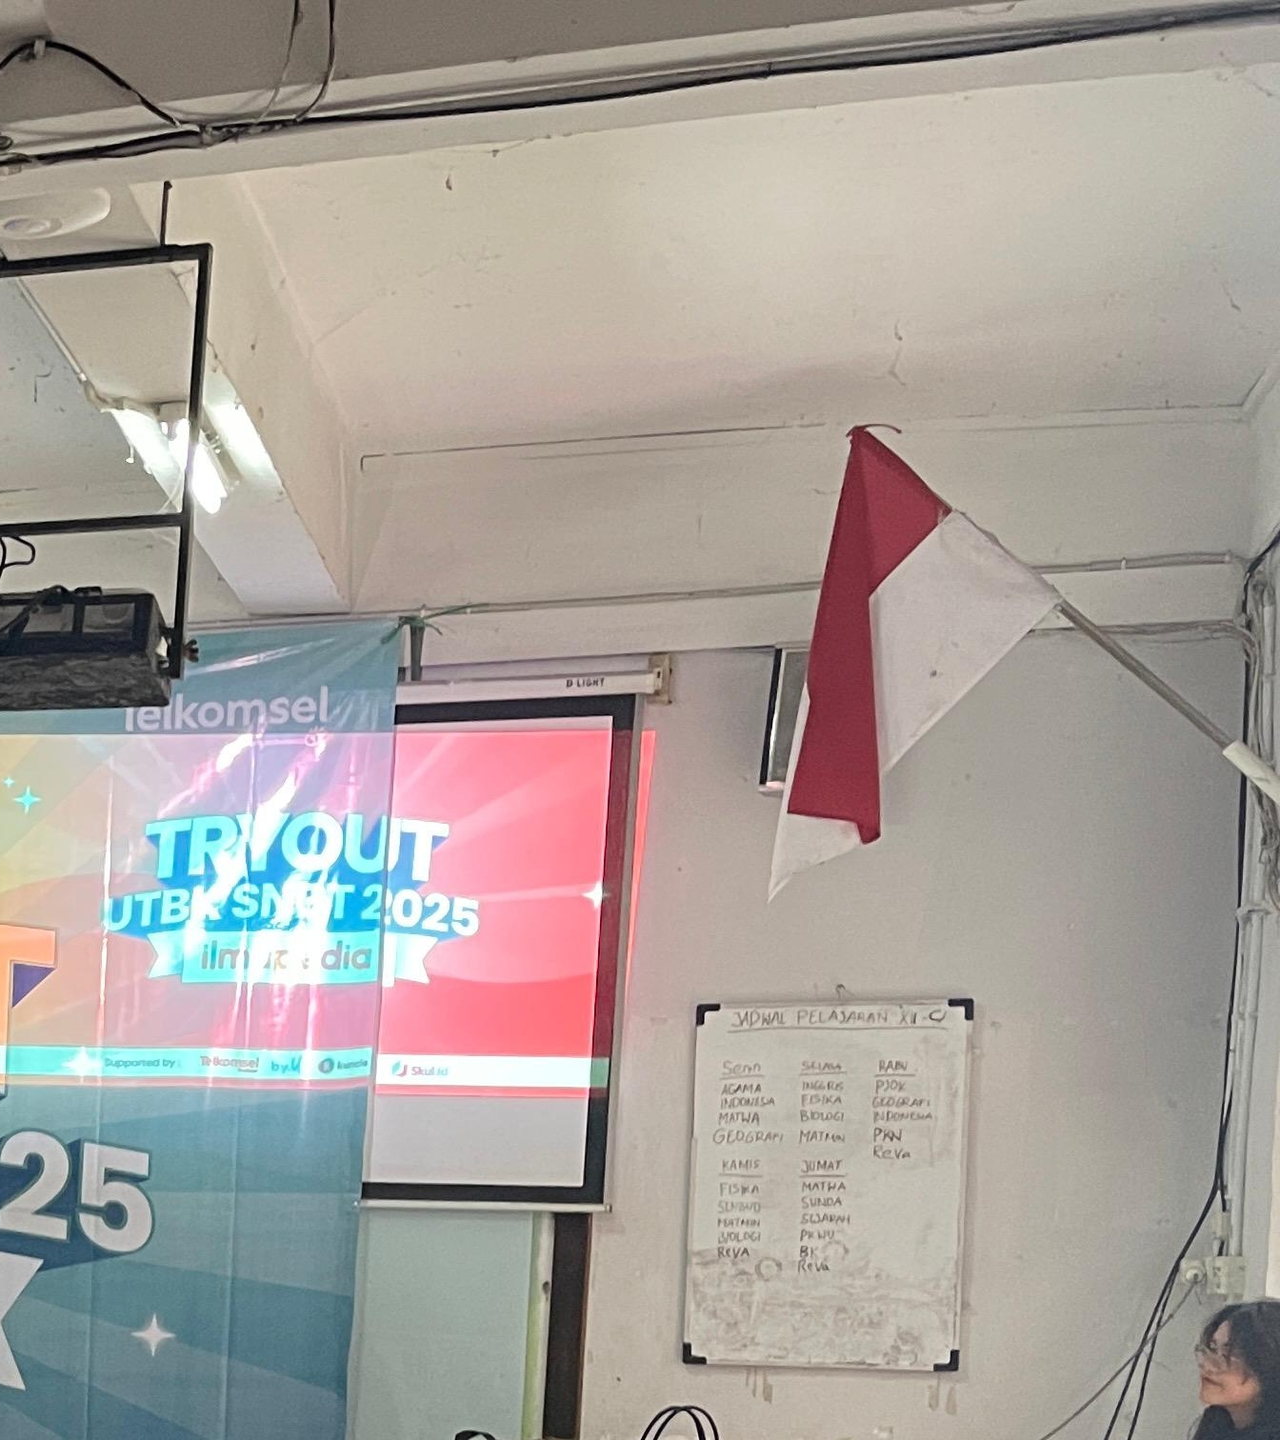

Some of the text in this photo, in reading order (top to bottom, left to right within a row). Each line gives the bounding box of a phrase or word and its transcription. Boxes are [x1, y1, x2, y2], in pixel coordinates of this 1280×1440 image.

[145, 813, 450, 883] TRYOUT
[102, 886, 222, 932] UTBK
[361, 885, 481, 937] 2025
[731, 1011, 786, 1028] JADWAL
[797, 1009, 888, 1025] PELAJARAN
[721, 1083, 762, 1096] AGAMA
[800, 1111, 845, 1123] BIOLOGI
[712, 1128, 784, 1145] GEOGRAFI
[722, 1159, 761, 1173] KAMIS
[800, 1159, 843, 1173] JUMAT
[801, 1196, 843, 1209] SUNDA
